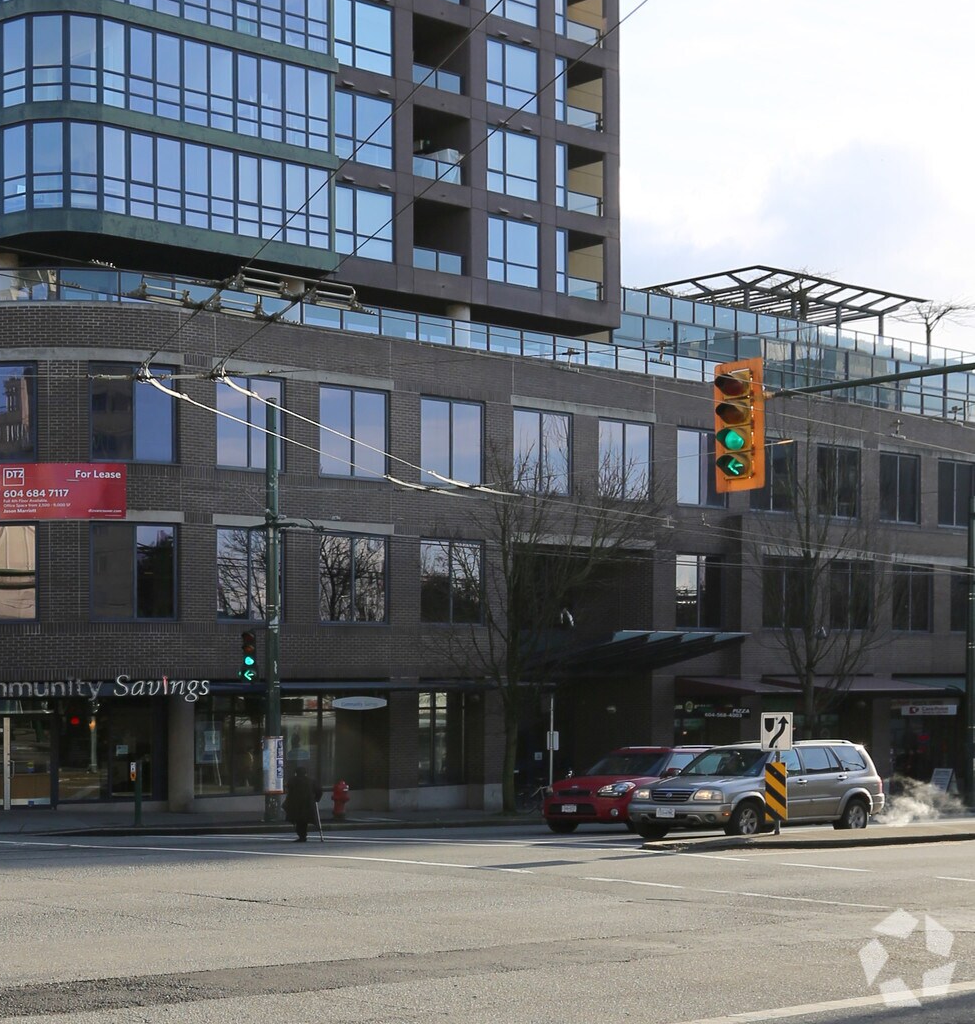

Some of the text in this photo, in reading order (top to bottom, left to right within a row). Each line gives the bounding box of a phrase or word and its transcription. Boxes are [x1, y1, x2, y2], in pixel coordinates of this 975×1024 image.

[6, 470, 24, 478] DTZ
[75, 469, 121, 479] For Lease
[3, 489, 69, 497] 604 684 7117
[113, 674, 210, 703] Savings
